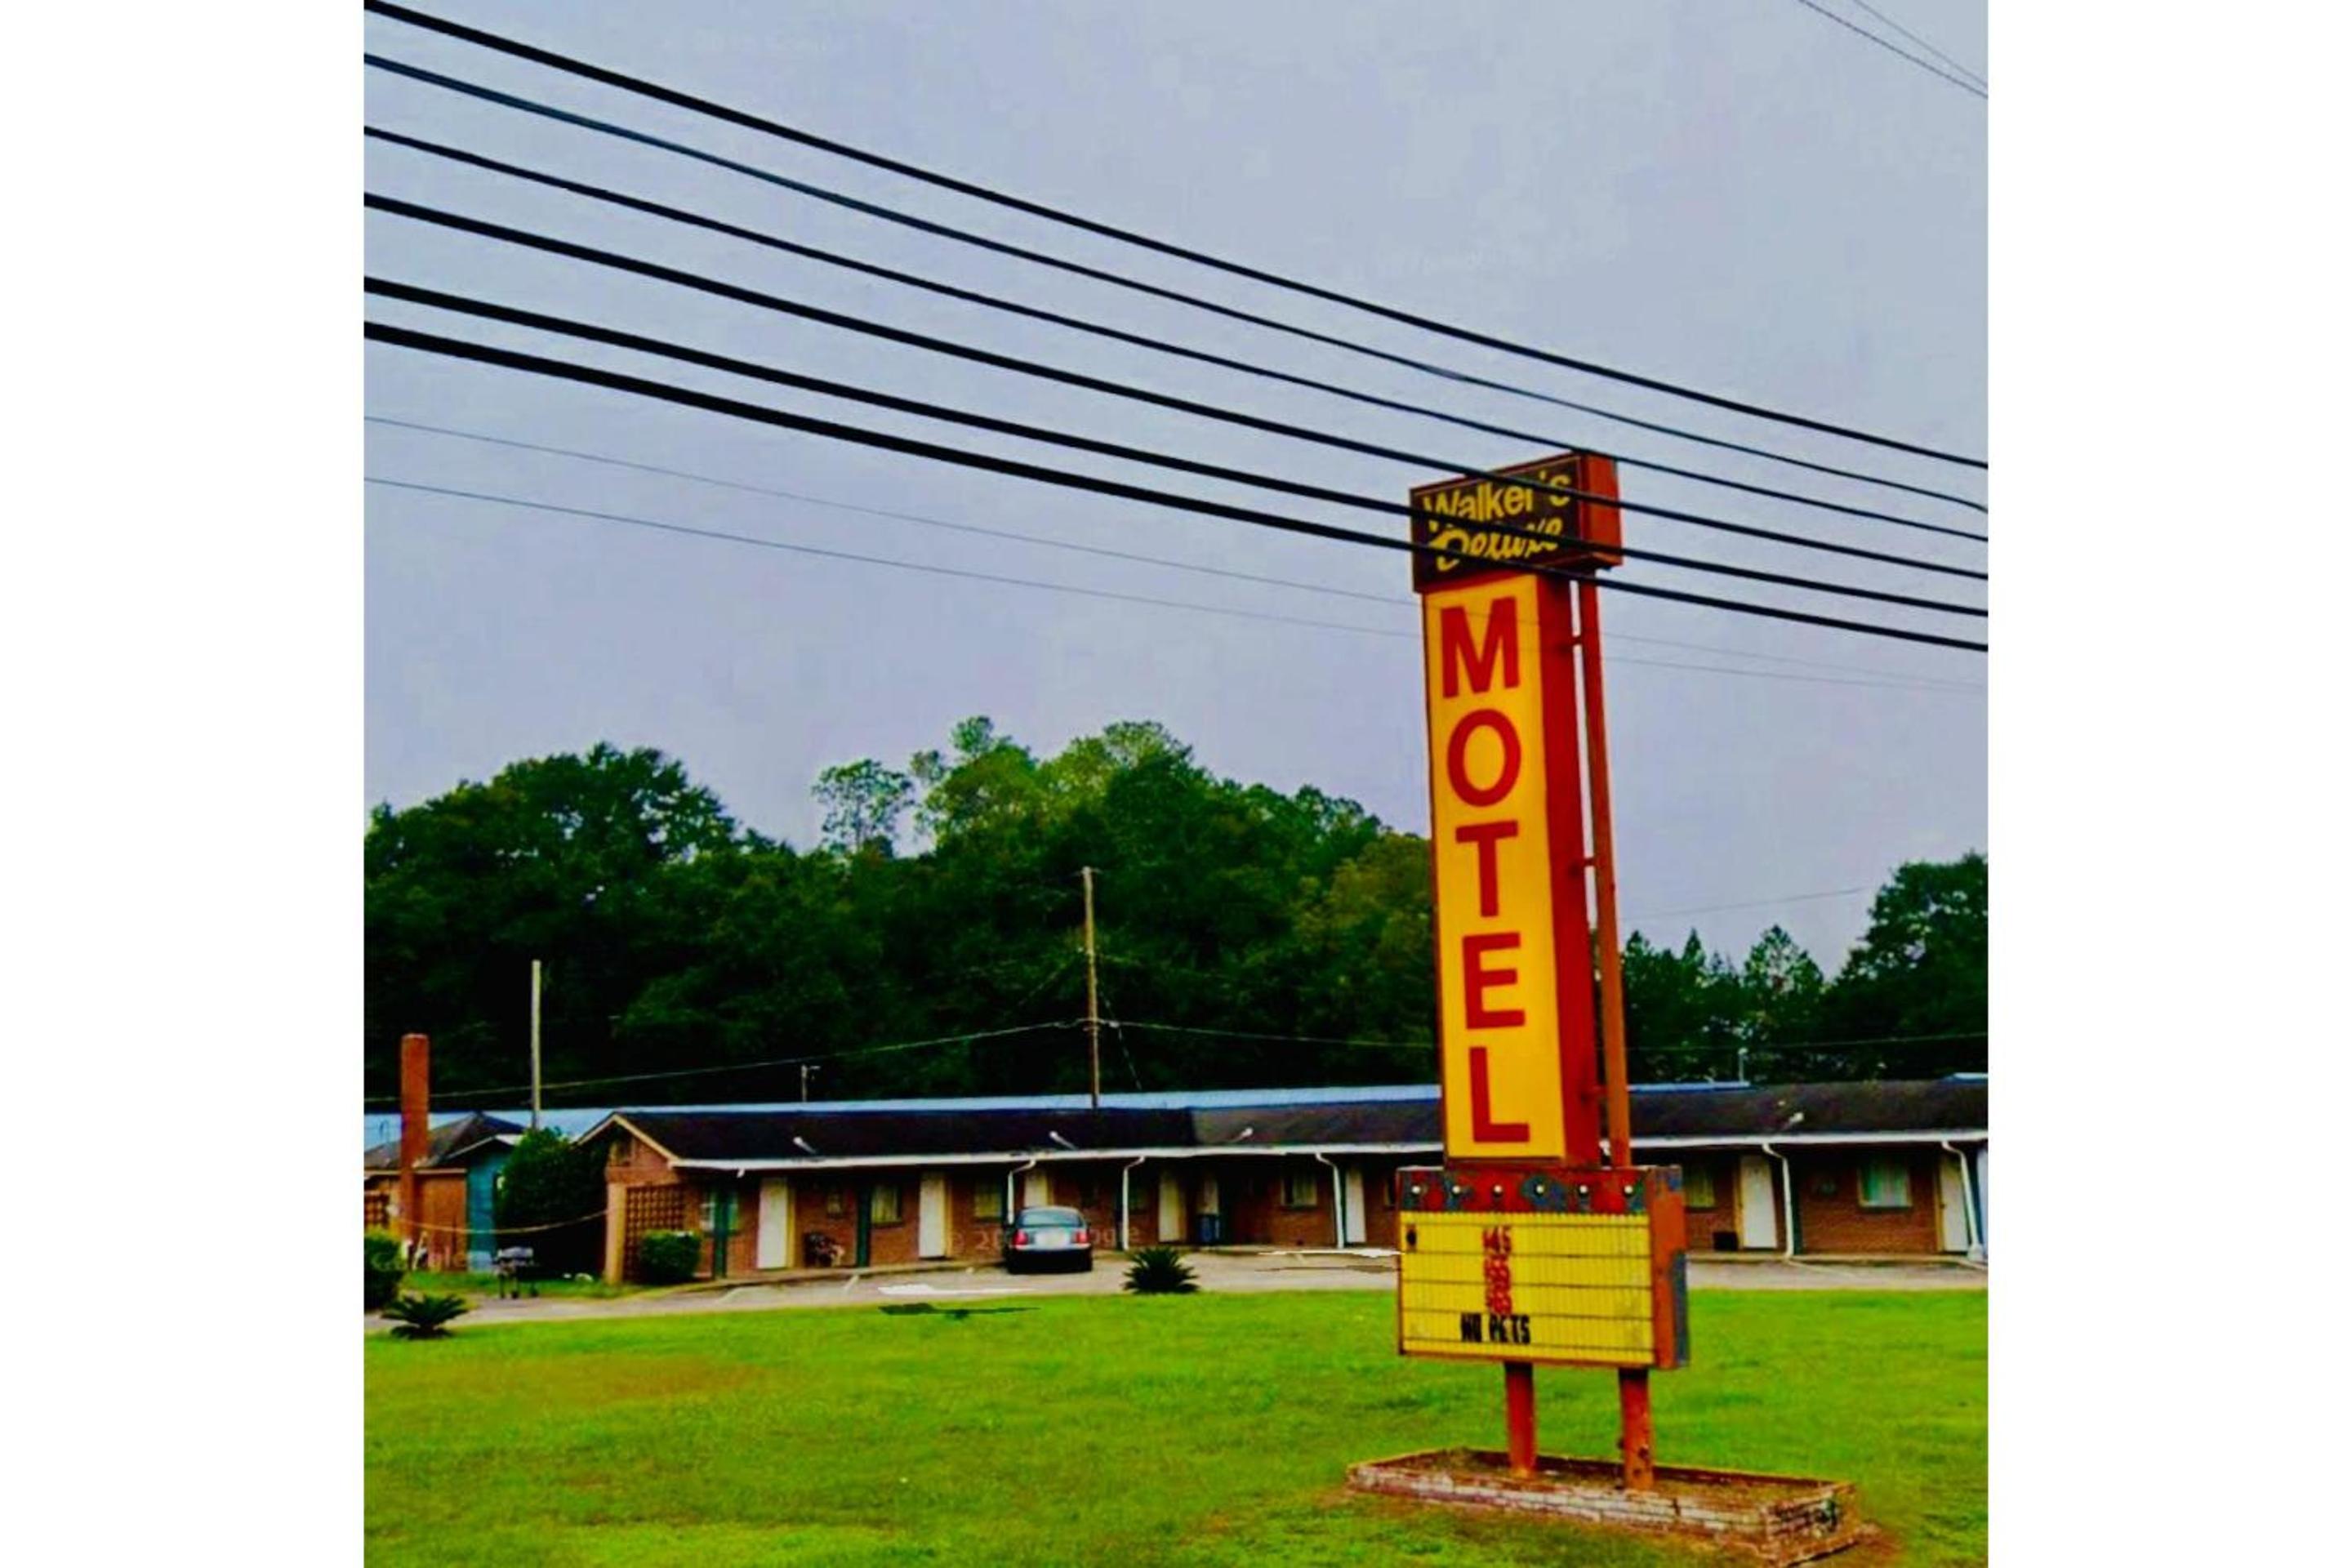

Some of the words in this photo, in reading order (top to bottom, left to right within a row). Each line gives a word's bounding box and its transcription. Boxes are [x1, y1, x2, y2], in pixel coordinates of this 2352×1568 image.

[1439, 596, 1531, 1143] MOTEL
[1461, 1312, 1482, 1343] NO
[1489, 1313, 1531, 1346] PETS
